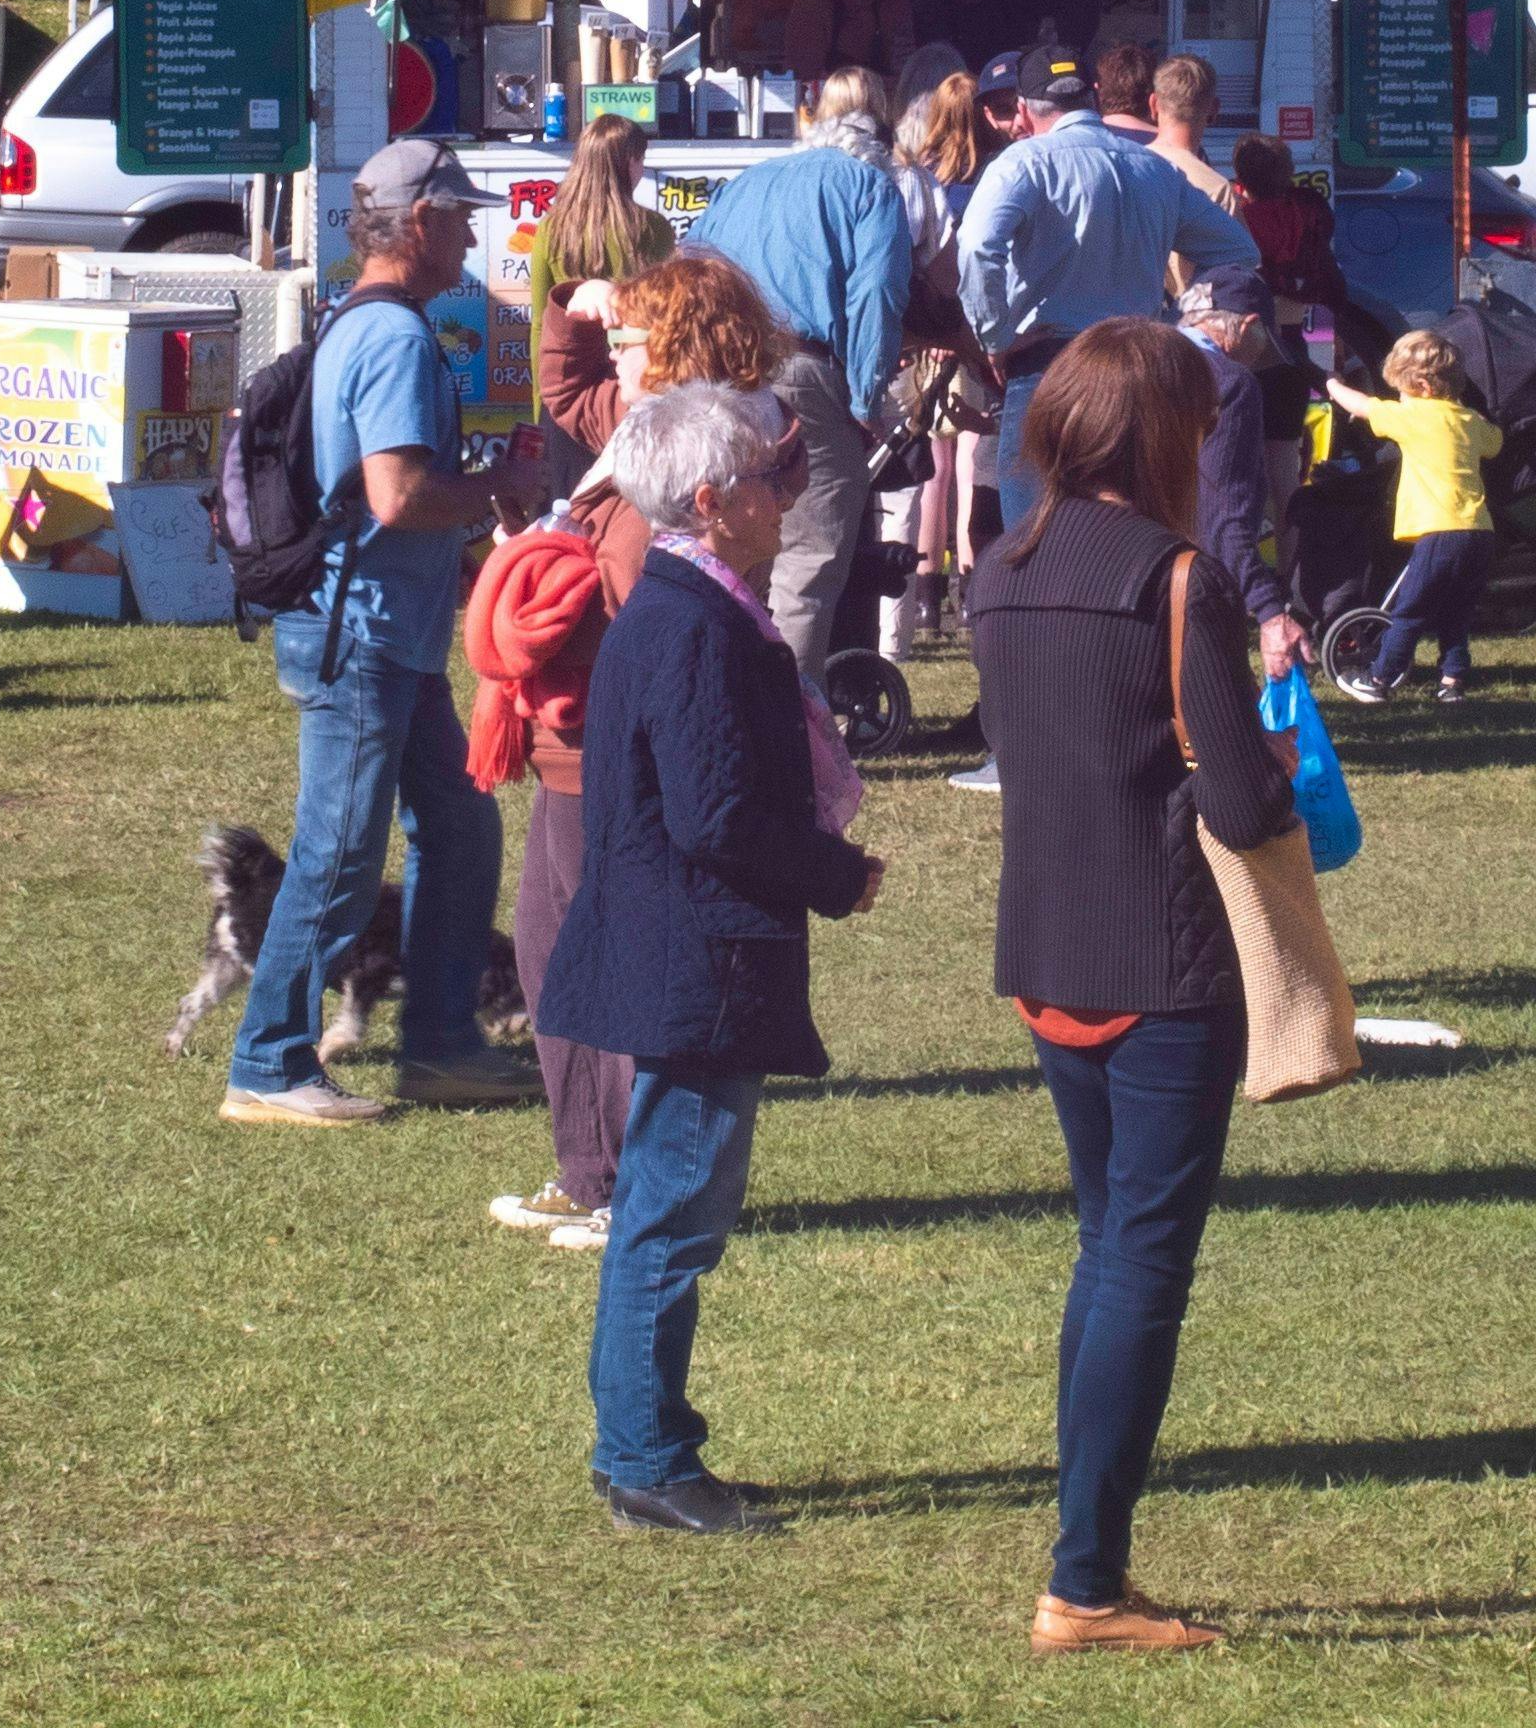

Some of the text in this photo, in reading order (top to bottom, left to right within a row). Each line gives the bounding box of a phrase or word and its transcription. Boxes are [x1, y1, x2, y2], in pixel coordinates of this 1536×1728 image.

[186, 2, 217, 12] Juices
[157, 17, 215, 27] Fruit Juices
[1379, 12, 1402, 22] Fruit
[157, 32, 213, 43] Apple Juice
[1379, 27, 1406, 38] Apple
[1379, 57, 1426, 69] Pineapple
[157, 63, 206, 75] Pineapple
[157, 86, 241, 97] Lemon Squash or
[1379, 81, 1448, 91] Lemon Squash
[590, 91, 652, 103] STRAWS
[1379, 95, 1411, 106] Mango
[157, 100, 219, 111] Mango Juice
[1379, 122, 1412, 133] Orange
[1427, 122, 1453, 133] Mang
[158, 128, 193, 138] Orange
[207, 128, 240, 139] Mango
[158, 142, 211, 153] Smoothies
[145, 417, 211, 454] HAP'S
